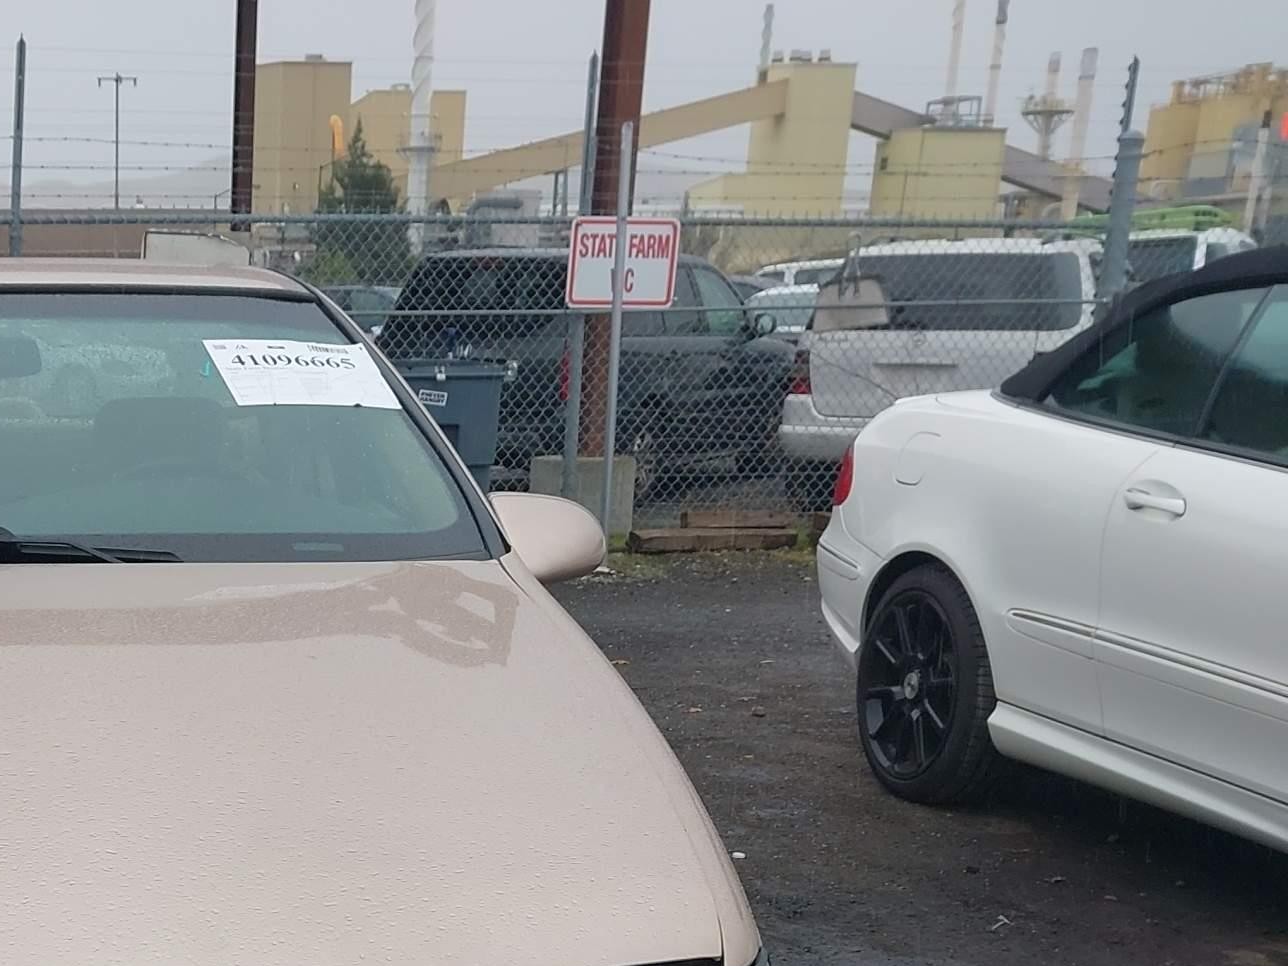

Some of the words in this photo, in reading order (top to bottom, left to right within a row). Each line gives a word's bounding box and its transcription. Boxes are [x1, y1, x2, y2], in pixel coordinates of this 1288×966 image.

[578, 232, 617, 259] STAT
[627, 233, 671, 260] FARM
[231, 353, 356, 370] 41096665
